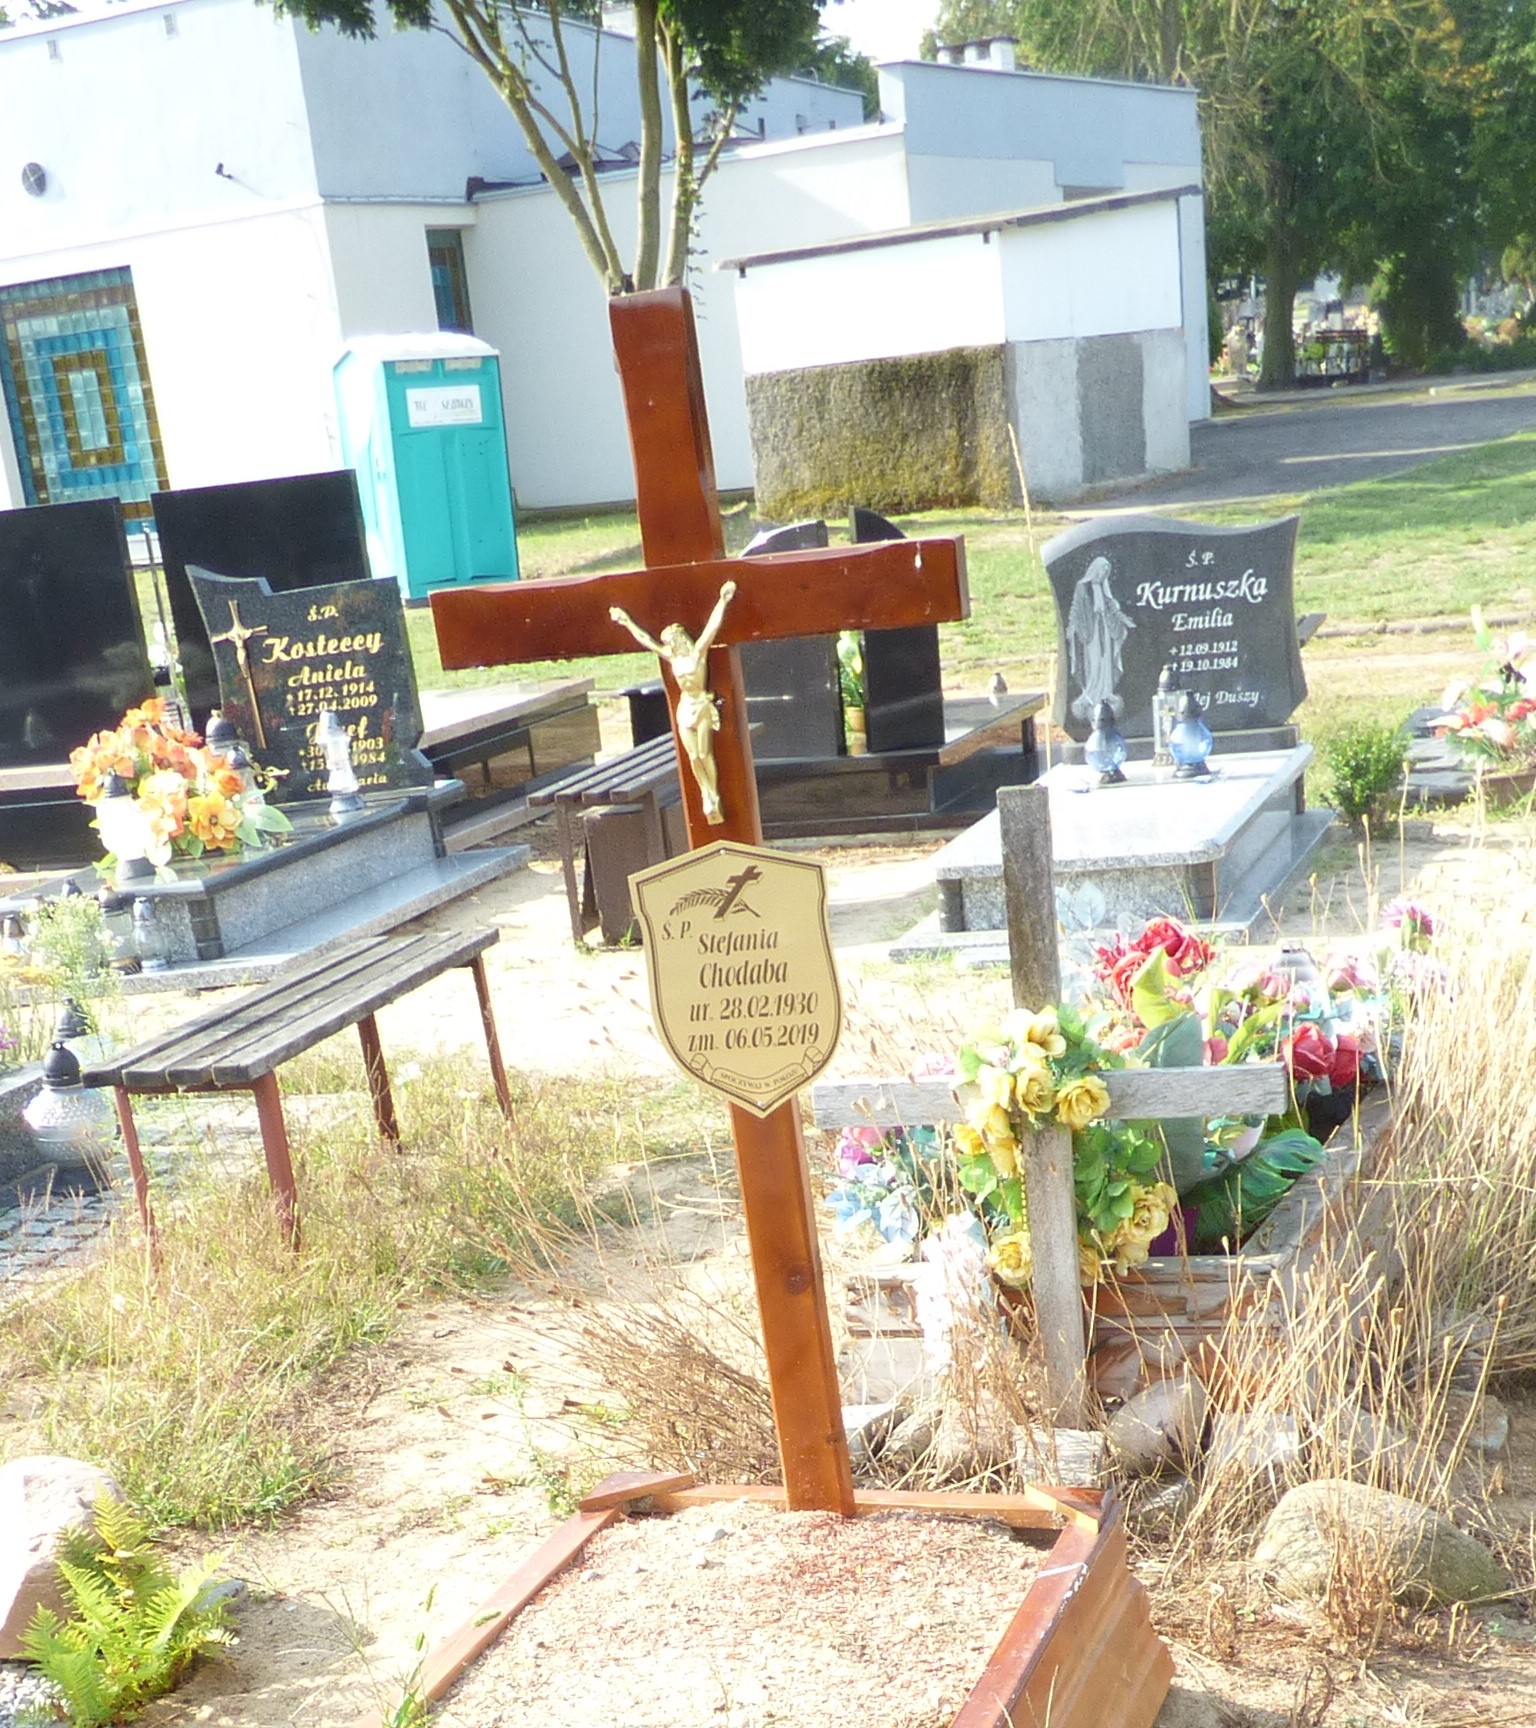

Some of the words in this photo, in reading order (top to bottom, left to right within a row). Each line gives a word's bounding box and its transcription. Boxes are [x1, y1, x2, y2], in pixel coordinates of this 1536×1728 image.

[1136, 569, 1268, 609] Kurnuszka
[1171, 607, 1233, 631] Emilia
[262, 632, 384, 663] Kosteccy
[288, 660, 367, 687] Aniela
[698, 928, 778, 956] Stefania
[699, 958, 788, 989] Chodaba
[720, 991, 819, 1020] 28.02.1930
[688, 1034, 719, 1052] zm.
[725, 1022, 819, 1049] 06.05.2019
